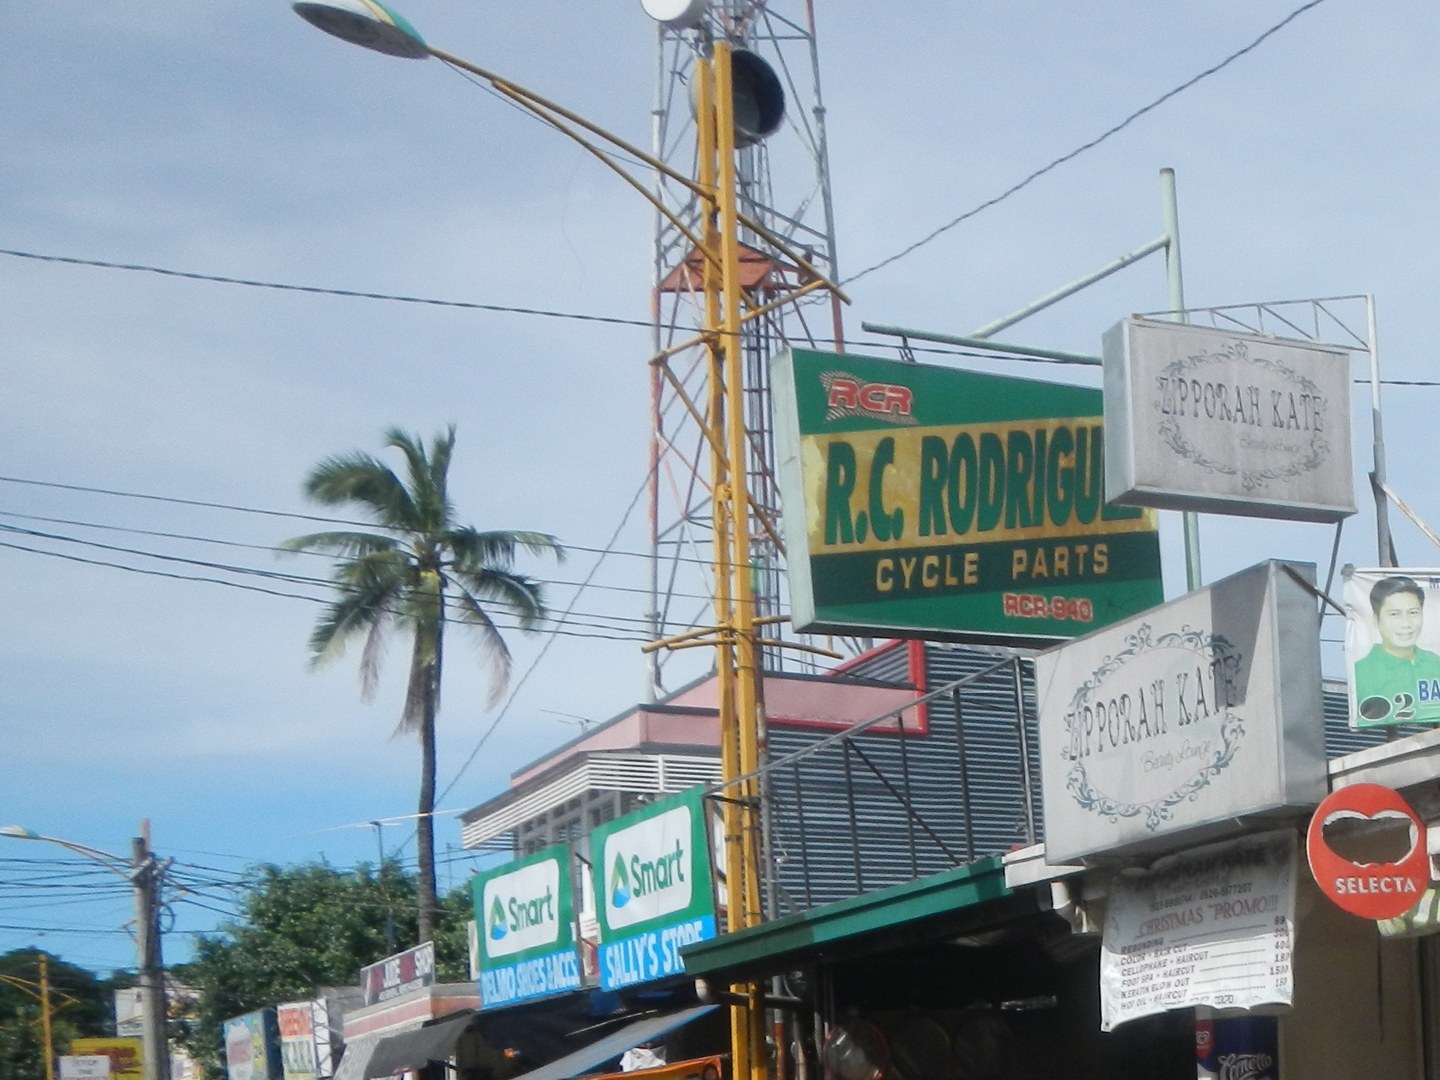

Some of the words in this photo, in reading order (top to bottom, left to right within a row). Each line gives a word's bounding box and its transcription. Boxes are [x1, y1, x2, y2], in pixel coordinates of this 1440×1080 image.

[828, 378, 913, 416] RCR
[1160, 376, 1263, 428] ZIPPORAH
[1270, 390, 1324, 433] KATE
[823, 436, 905, 546] R.C.
[918, 416, 1142, 537] RODRIGU
[875, 551, 980, 593] CYCLE
[1011, 542, 1110, 581] PARTS
[1003, 593, 1094, 622] RCR-940
[1066, 679, 1168, 762] ZIPPORAH
[1176, 656, 1238, 727] KATE
[630, 839, 685, 898] Smart
[1335, 875, 1417, 895] SELECTA
[508, 885, 555, 933] Smart
[605, 933, 660, 988] SALLY'S
[1173, 943, 1188, 953] CUT
[1176, 951, 1209, 964] HAIRCUT
[1162, 964, 1196, 979] HAIRCUT
[1174, 978, 1190, 988] OUT
